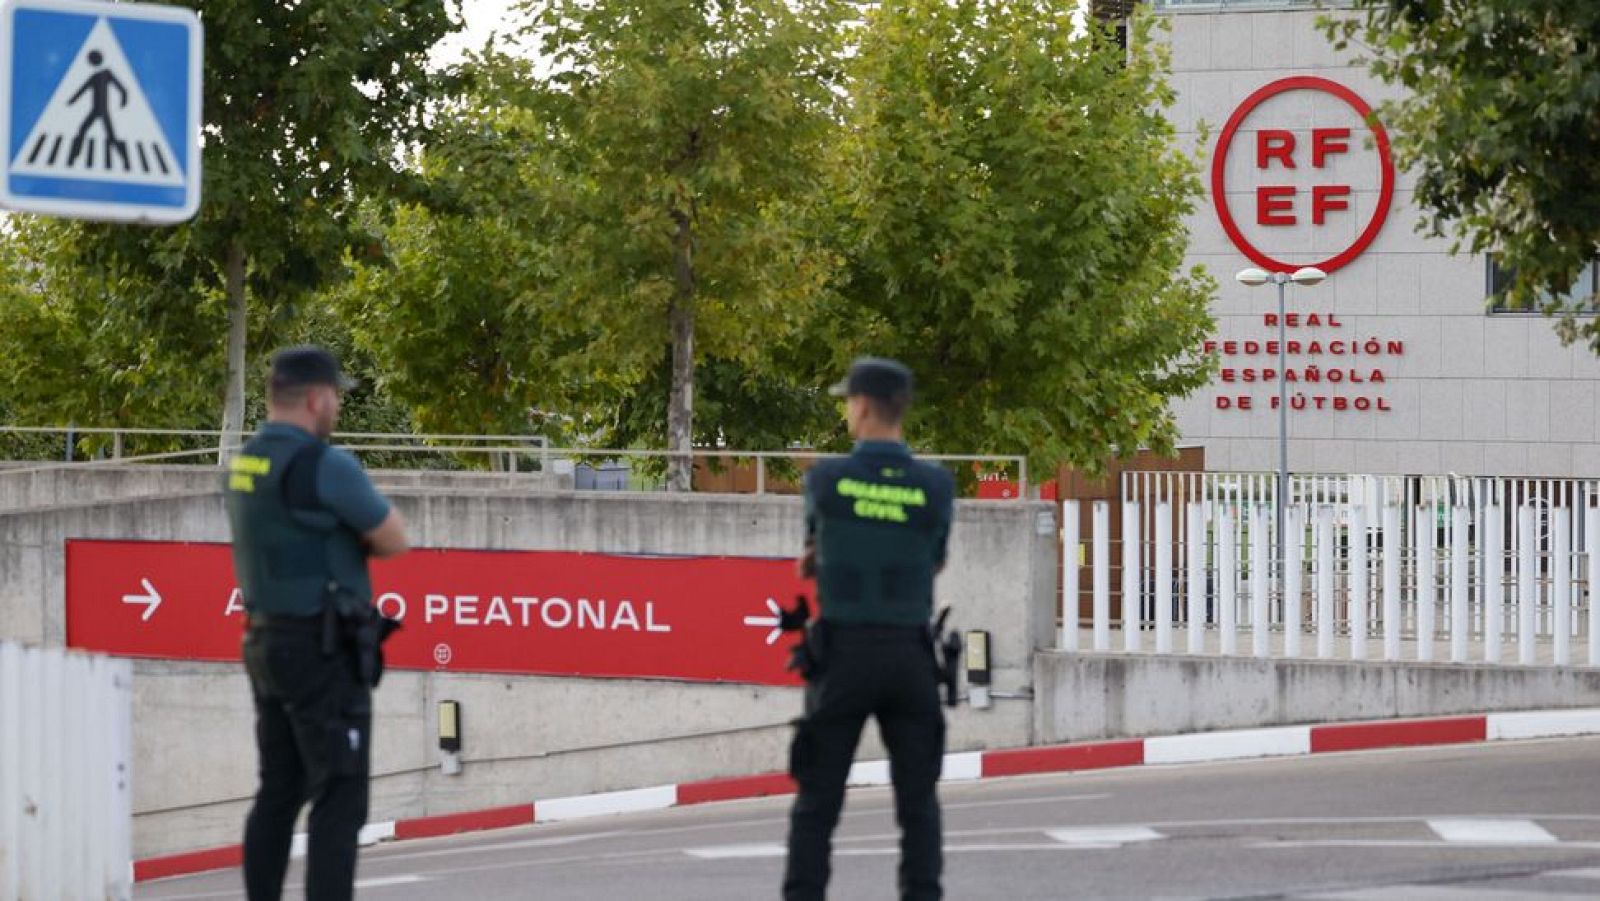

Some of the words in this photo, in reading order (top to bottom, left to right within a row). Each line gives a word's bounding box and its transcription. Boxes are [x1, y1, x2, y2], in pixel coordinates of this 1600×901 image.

[1264, 313, 1342, 327] REAL
[1203, 337, 1404, 355] FEDERACIÓN
[1221, 365, 1385, 383] ESPAÑOLA
[1216, 396, 1252, 410] DE
[424, 594, 672, 632] PEATONAL
